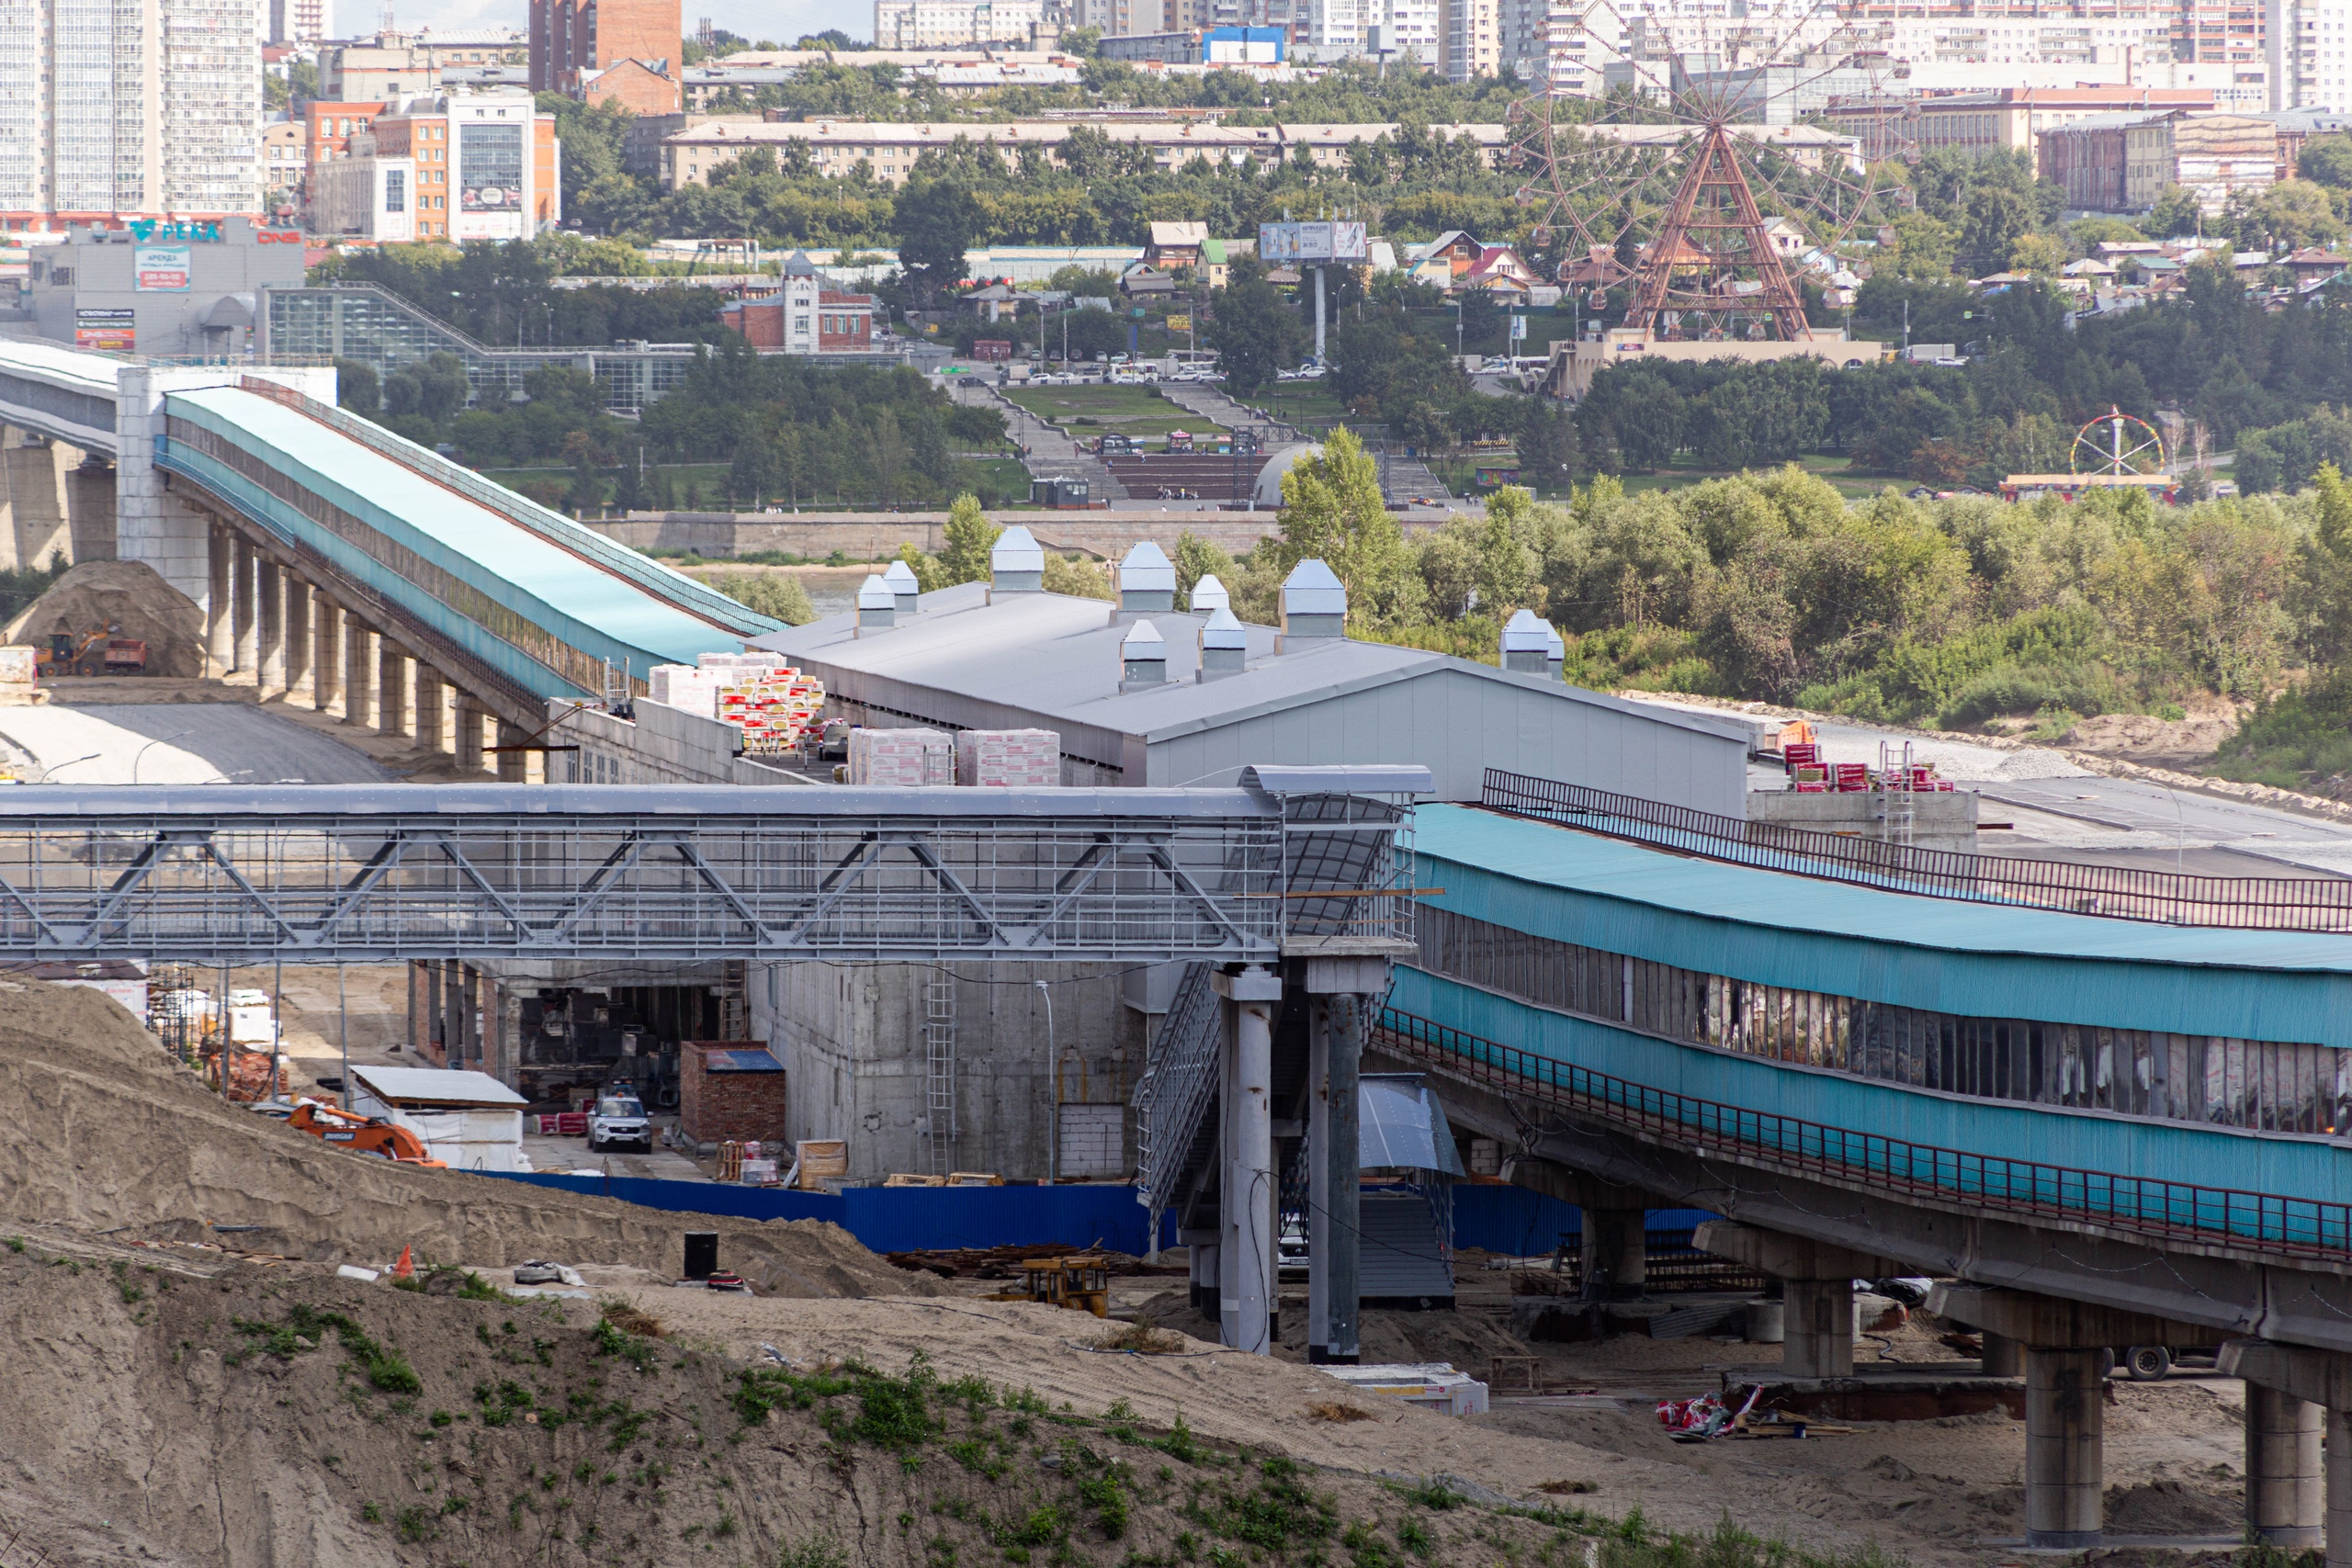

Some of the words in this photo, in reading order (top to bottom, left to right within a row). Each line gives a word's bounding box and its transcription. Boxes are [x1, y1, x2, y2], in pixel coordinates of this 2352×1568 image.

[162, 223, 220, 242] РЕКА
[256, 231, 302, 244] DNS
[147, 254, 177, 263] АРЕНДА
